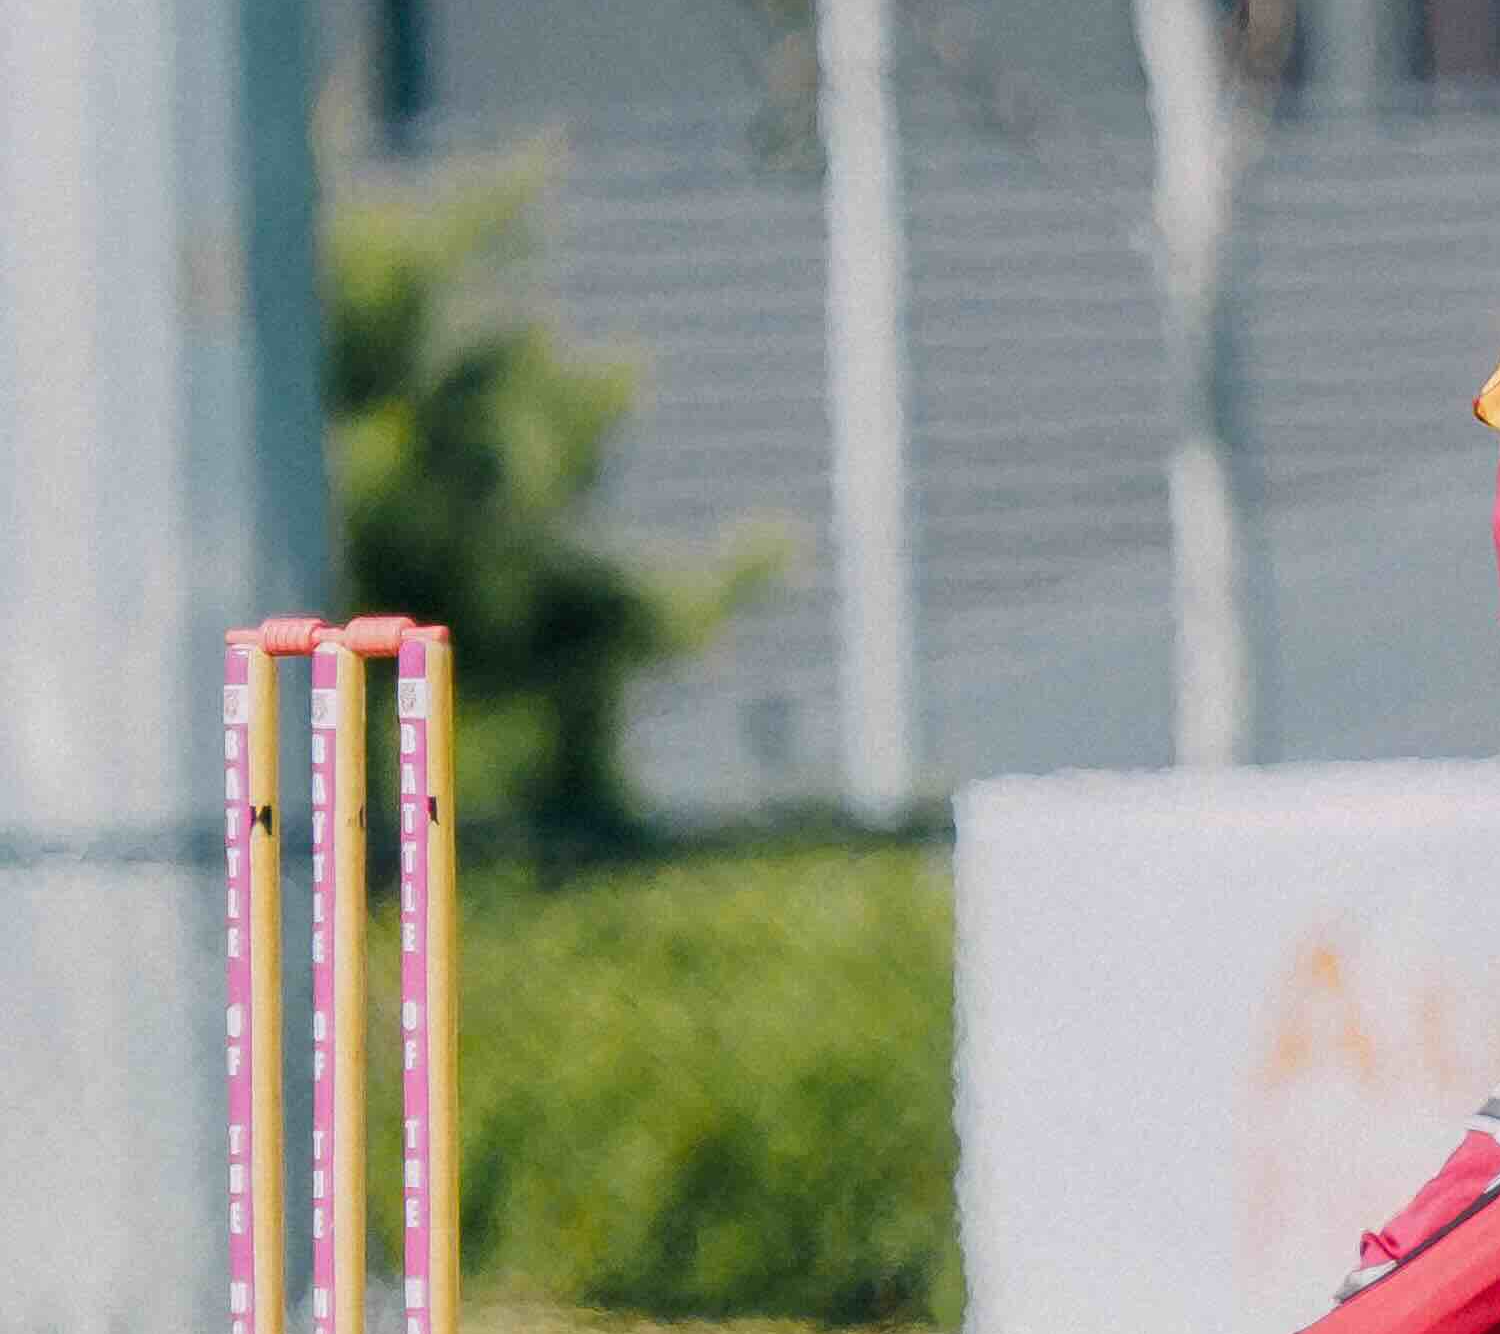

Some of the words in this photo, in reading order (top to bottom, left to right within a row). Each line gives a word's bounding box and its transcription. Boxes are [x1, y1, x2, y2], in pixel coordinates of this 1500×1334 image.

[224, 727, 240, 958] BATTLE
[311, 732, 326, 964] BATTLE
[400, 722, 417, 953] BATTLE
[226, 1004, 242, 1075] OF
[312, 1010, 326, 1081] OF
[402, 1001, 417, 1071] OF
[228, 1123, 243, 1235] THE
[313, 1130, 325, 1240] THE
[404, 1118, 420, 1228] THE
